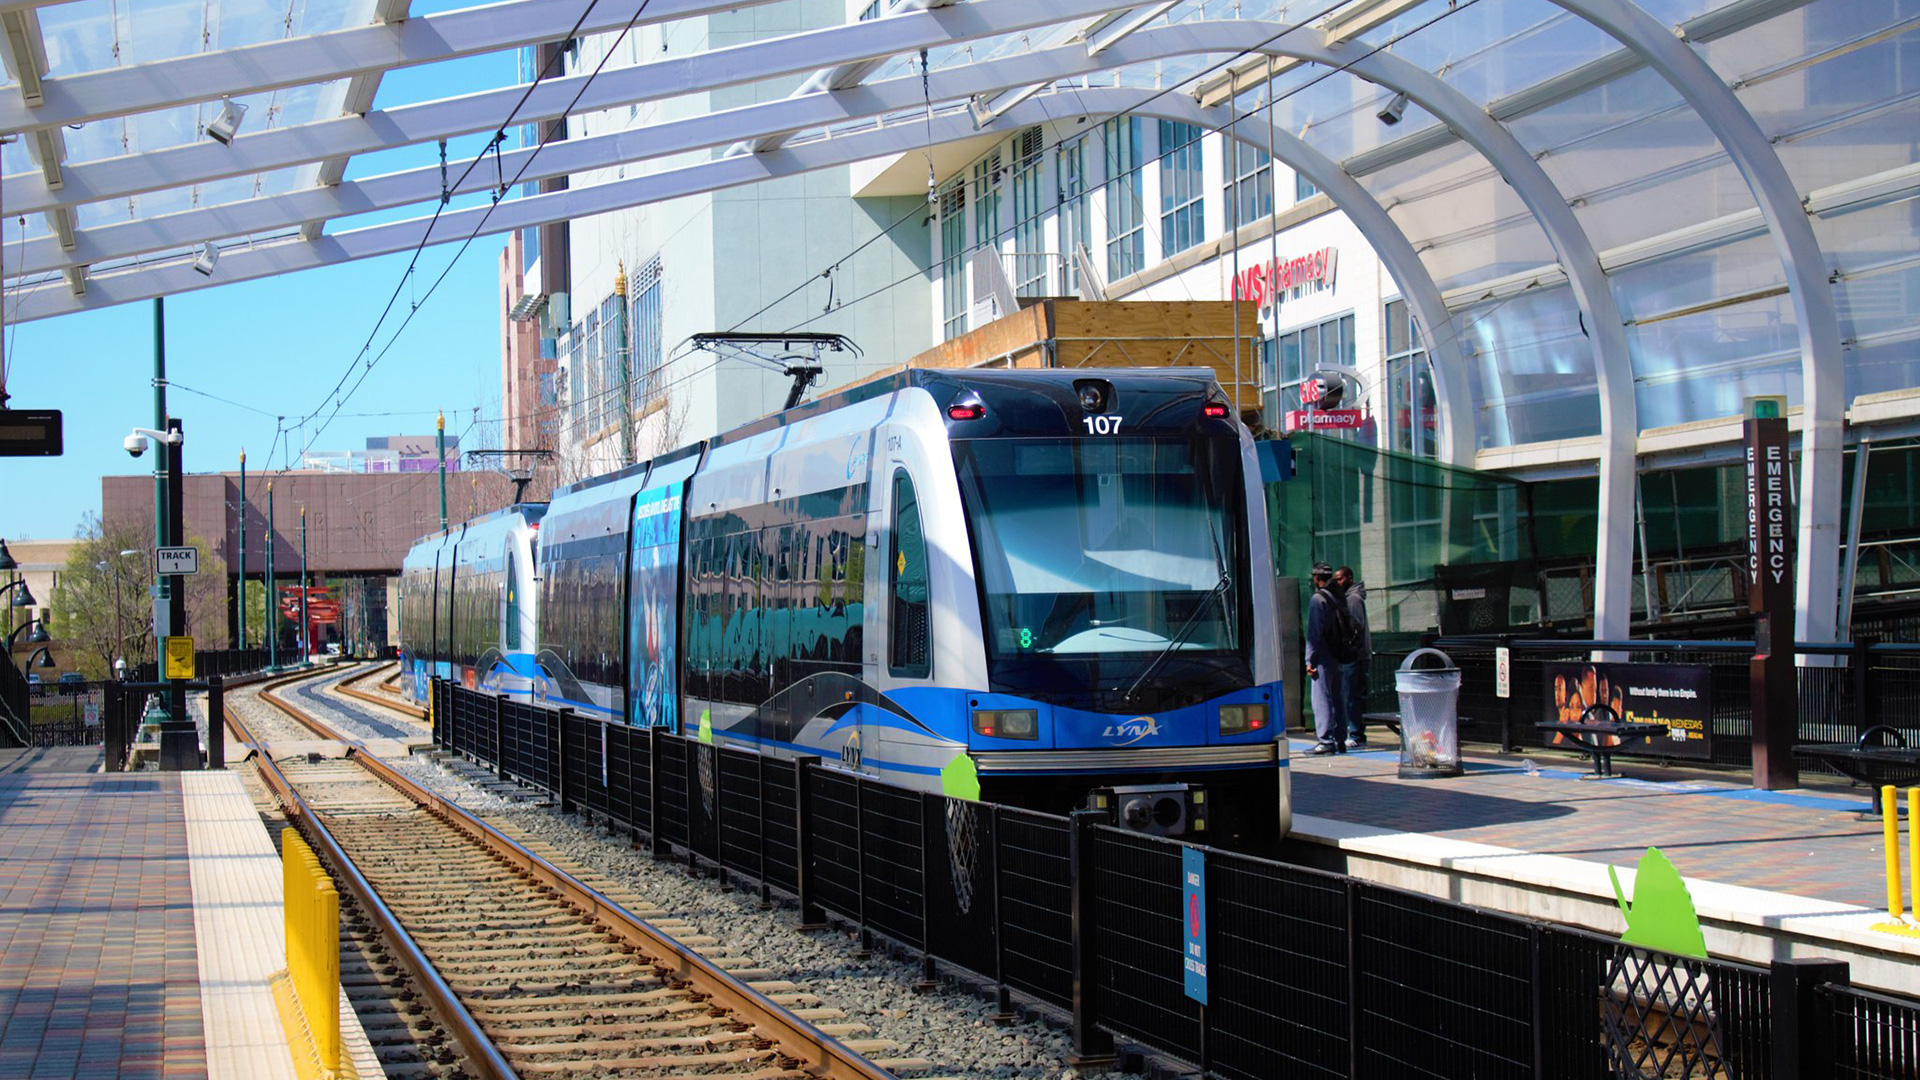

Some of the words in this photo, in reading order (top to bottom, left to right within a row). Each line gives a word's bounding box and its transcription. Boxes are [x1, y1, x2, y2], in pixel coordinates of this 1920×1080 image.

[1299, 379, 1320, 404] CVS
[1083, 416, 1122, 435] 107
[1300, 414, 1356, 426] parmacy
[1747, 447, 1758, 585] EMERGENCY
[1767, 446, 1784, 584] EMERGENCY
[161, 552, 191, 560] TRACK
[174, 562, 178, 570] 1
[1021, 628, 1031, 648] 8
[1102, 725, 1163, 737] LYNX
[842, 745, 861, 765] LYNX
